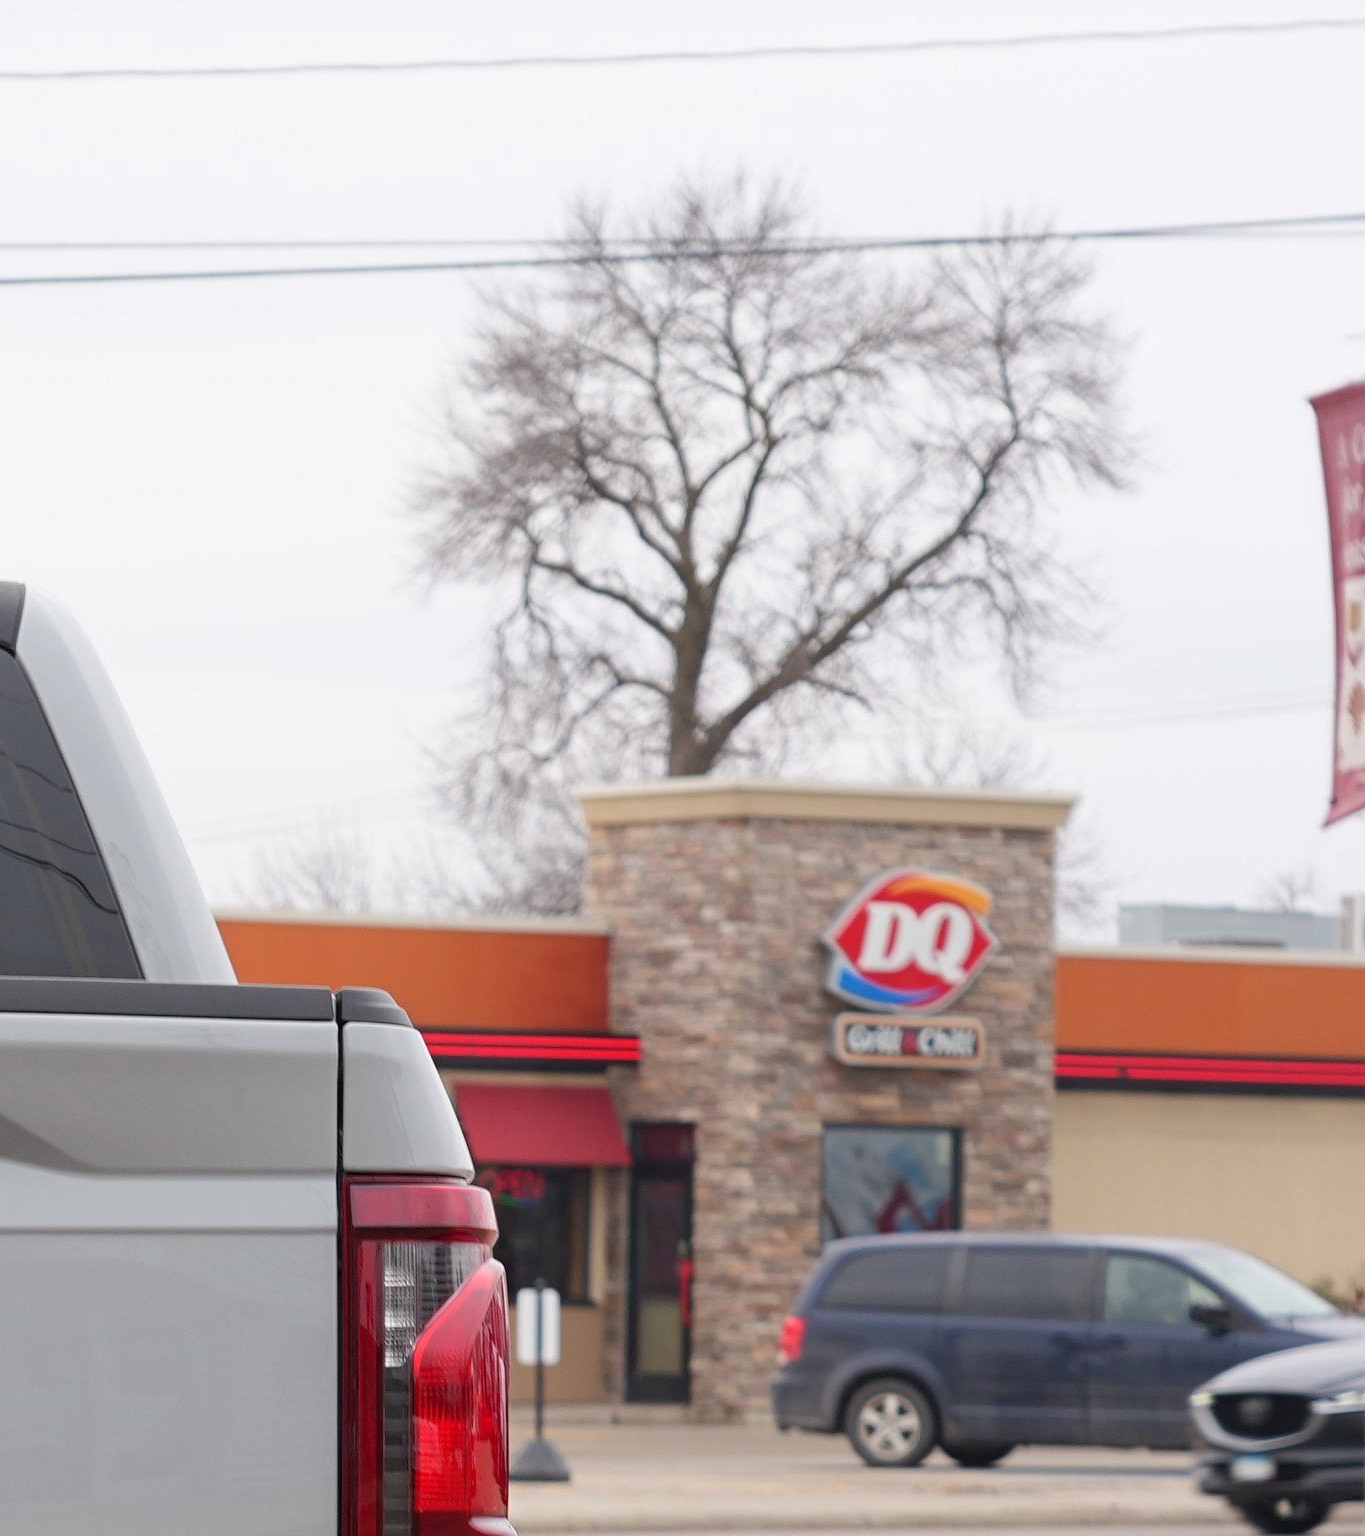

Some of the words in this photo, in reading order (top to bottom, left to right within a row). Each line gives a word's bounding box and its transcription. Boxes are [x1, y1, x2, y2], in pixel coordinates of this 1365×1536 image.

[859, 901, 975, 986] DQ
[847, 1024, 901, 1054] Grill
[919, 1026, 977, 1057] Chill
